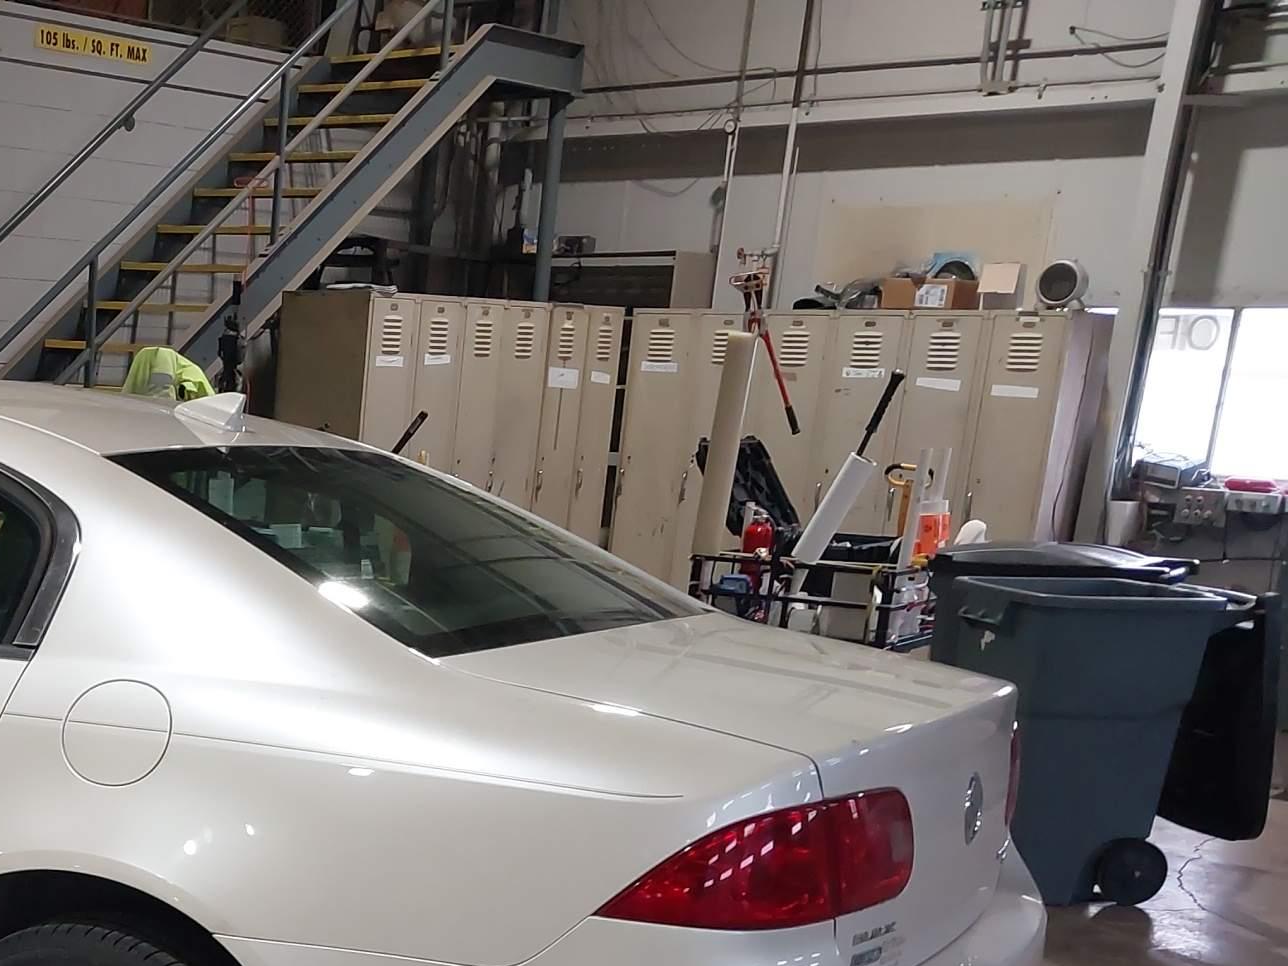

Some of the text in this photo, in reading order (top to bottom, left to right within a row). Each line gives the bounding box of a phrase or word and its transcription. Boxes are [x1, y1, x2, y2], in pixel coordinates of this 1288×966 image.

[40, 29, 148, 62] 105 lbs. / SQ. FT. MAX
